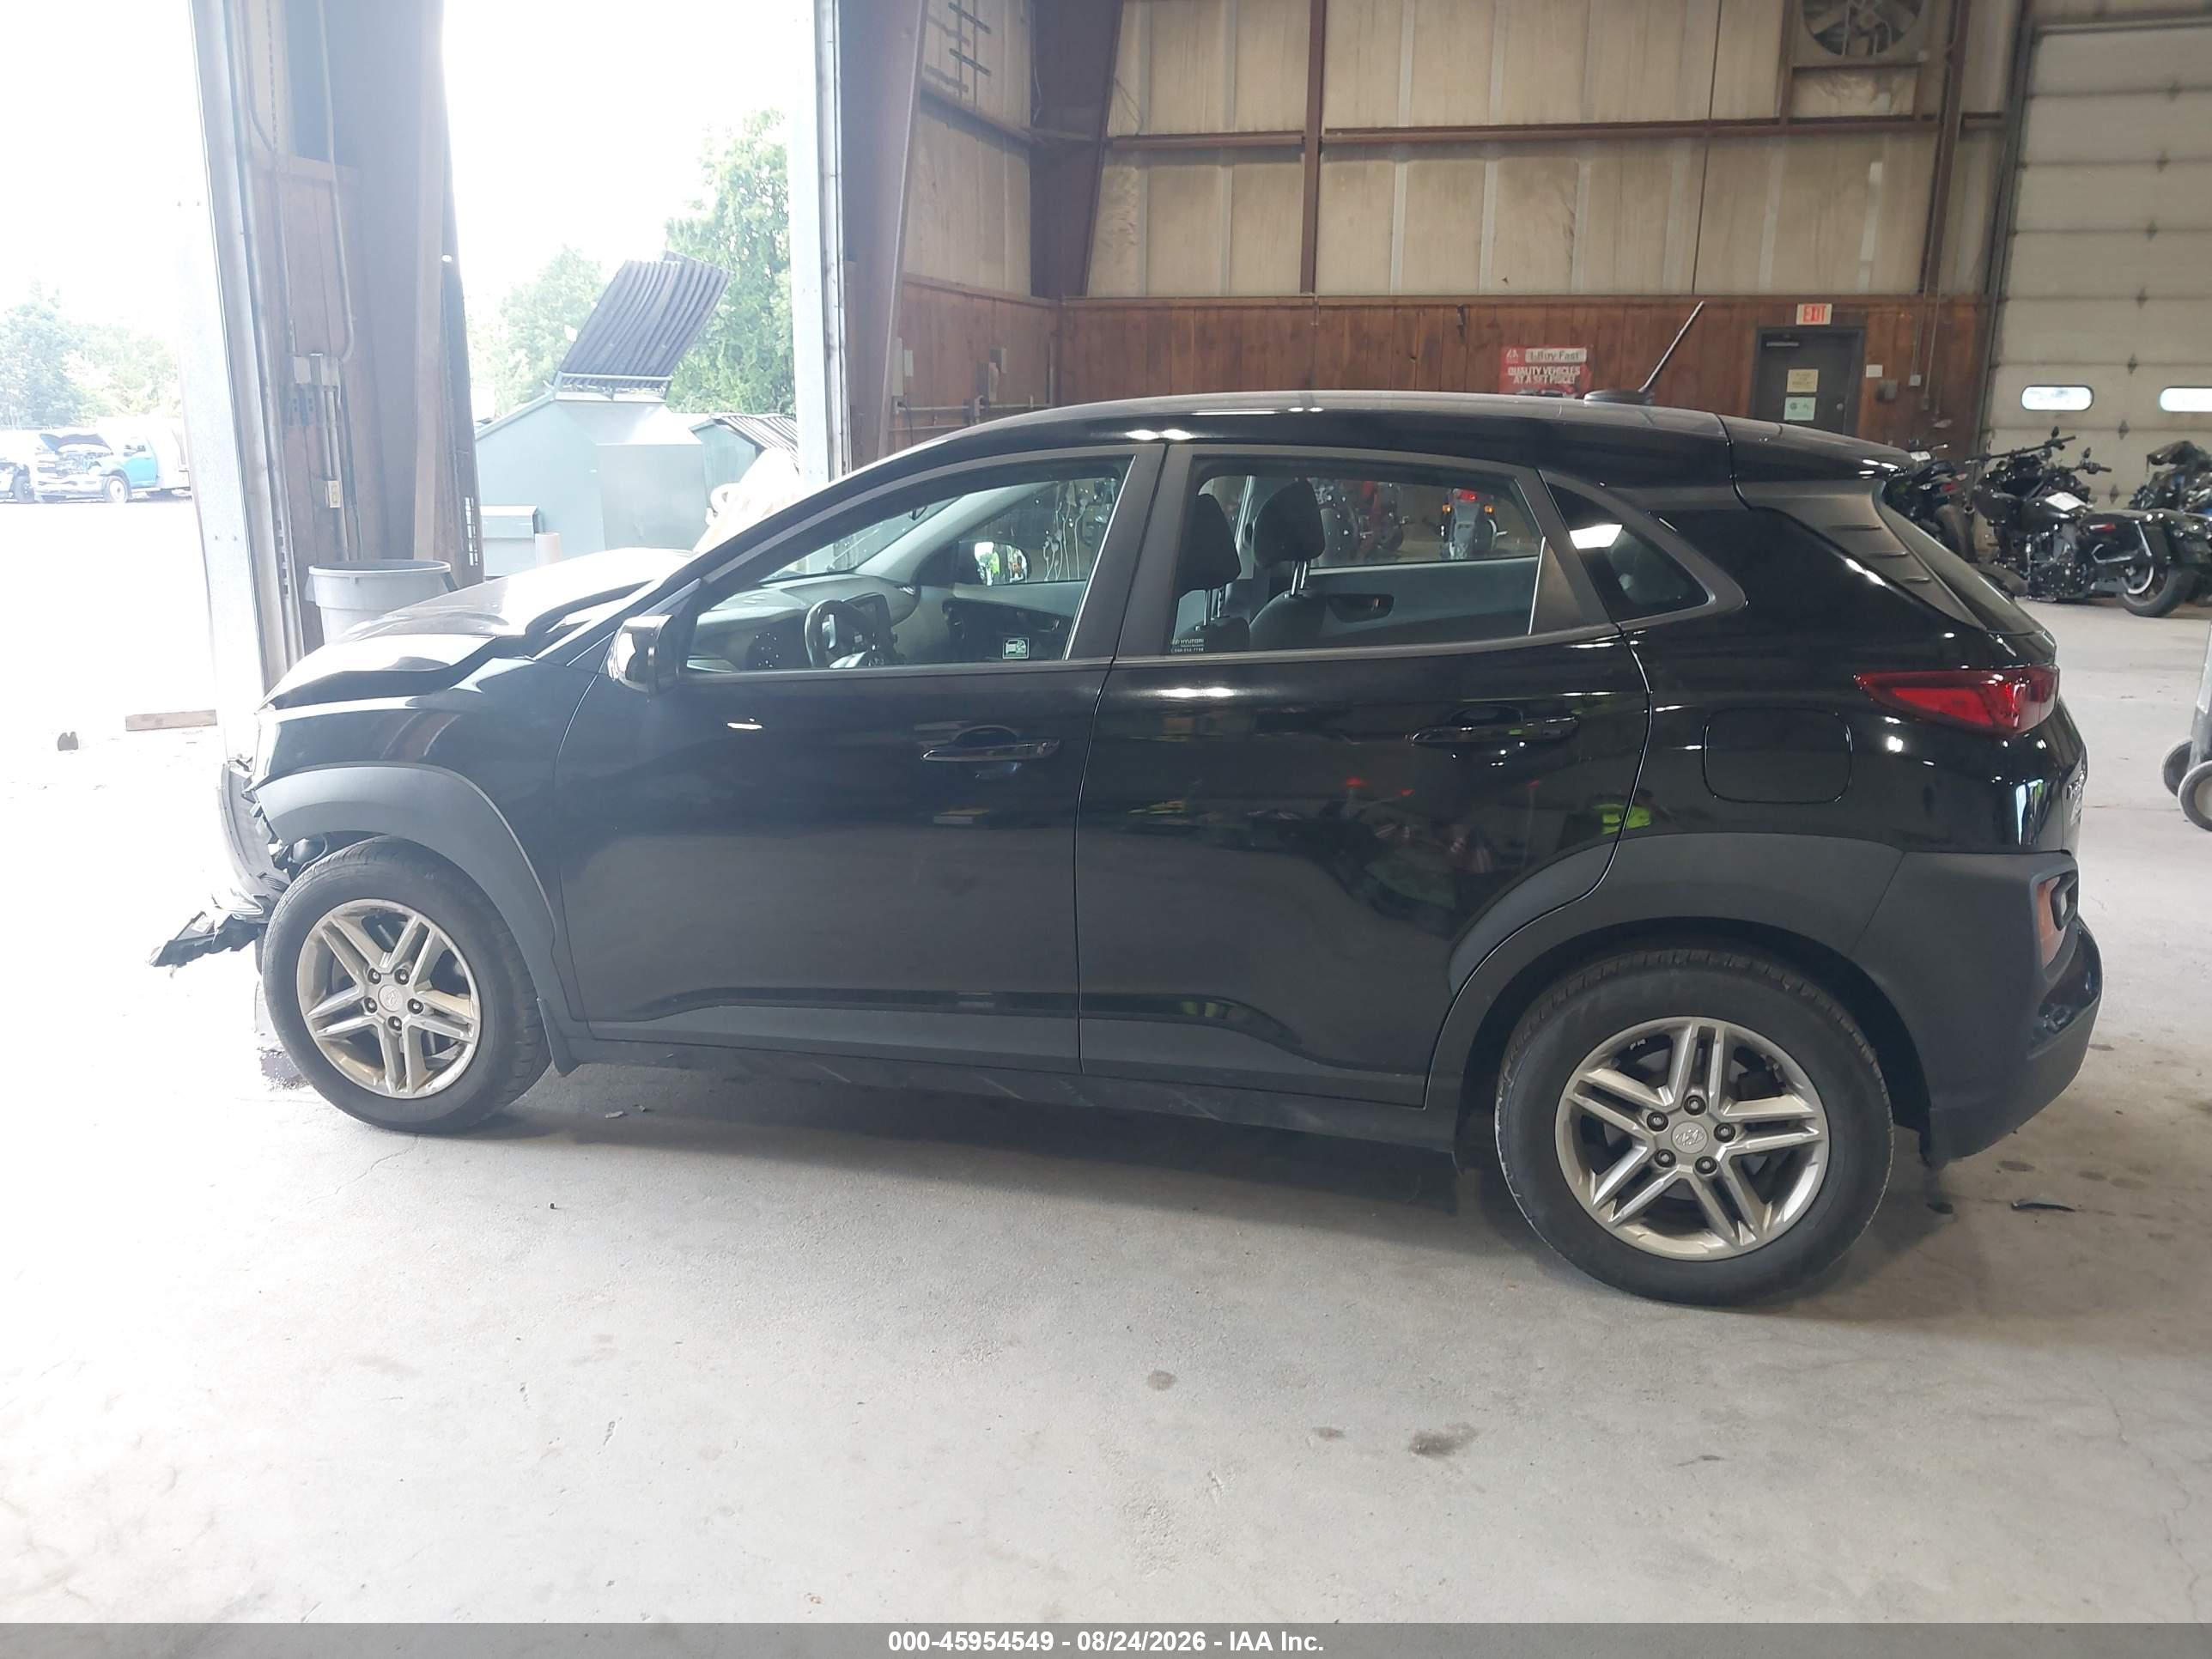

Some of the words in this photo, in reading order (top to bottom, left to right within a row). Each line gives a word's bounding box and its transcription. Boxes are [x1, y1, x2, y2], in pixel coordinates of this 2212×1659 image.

[1803, 306, 1826, 322] EXIT
[1559, 350, 1579, 360] Fast
[1508, 367, 1542, 375] QUALITY
[1543, 366, 1581, 375] VEHICLES
[1513, 375, 1524, 384] AT
[1525, 375, 1532, 384] A
